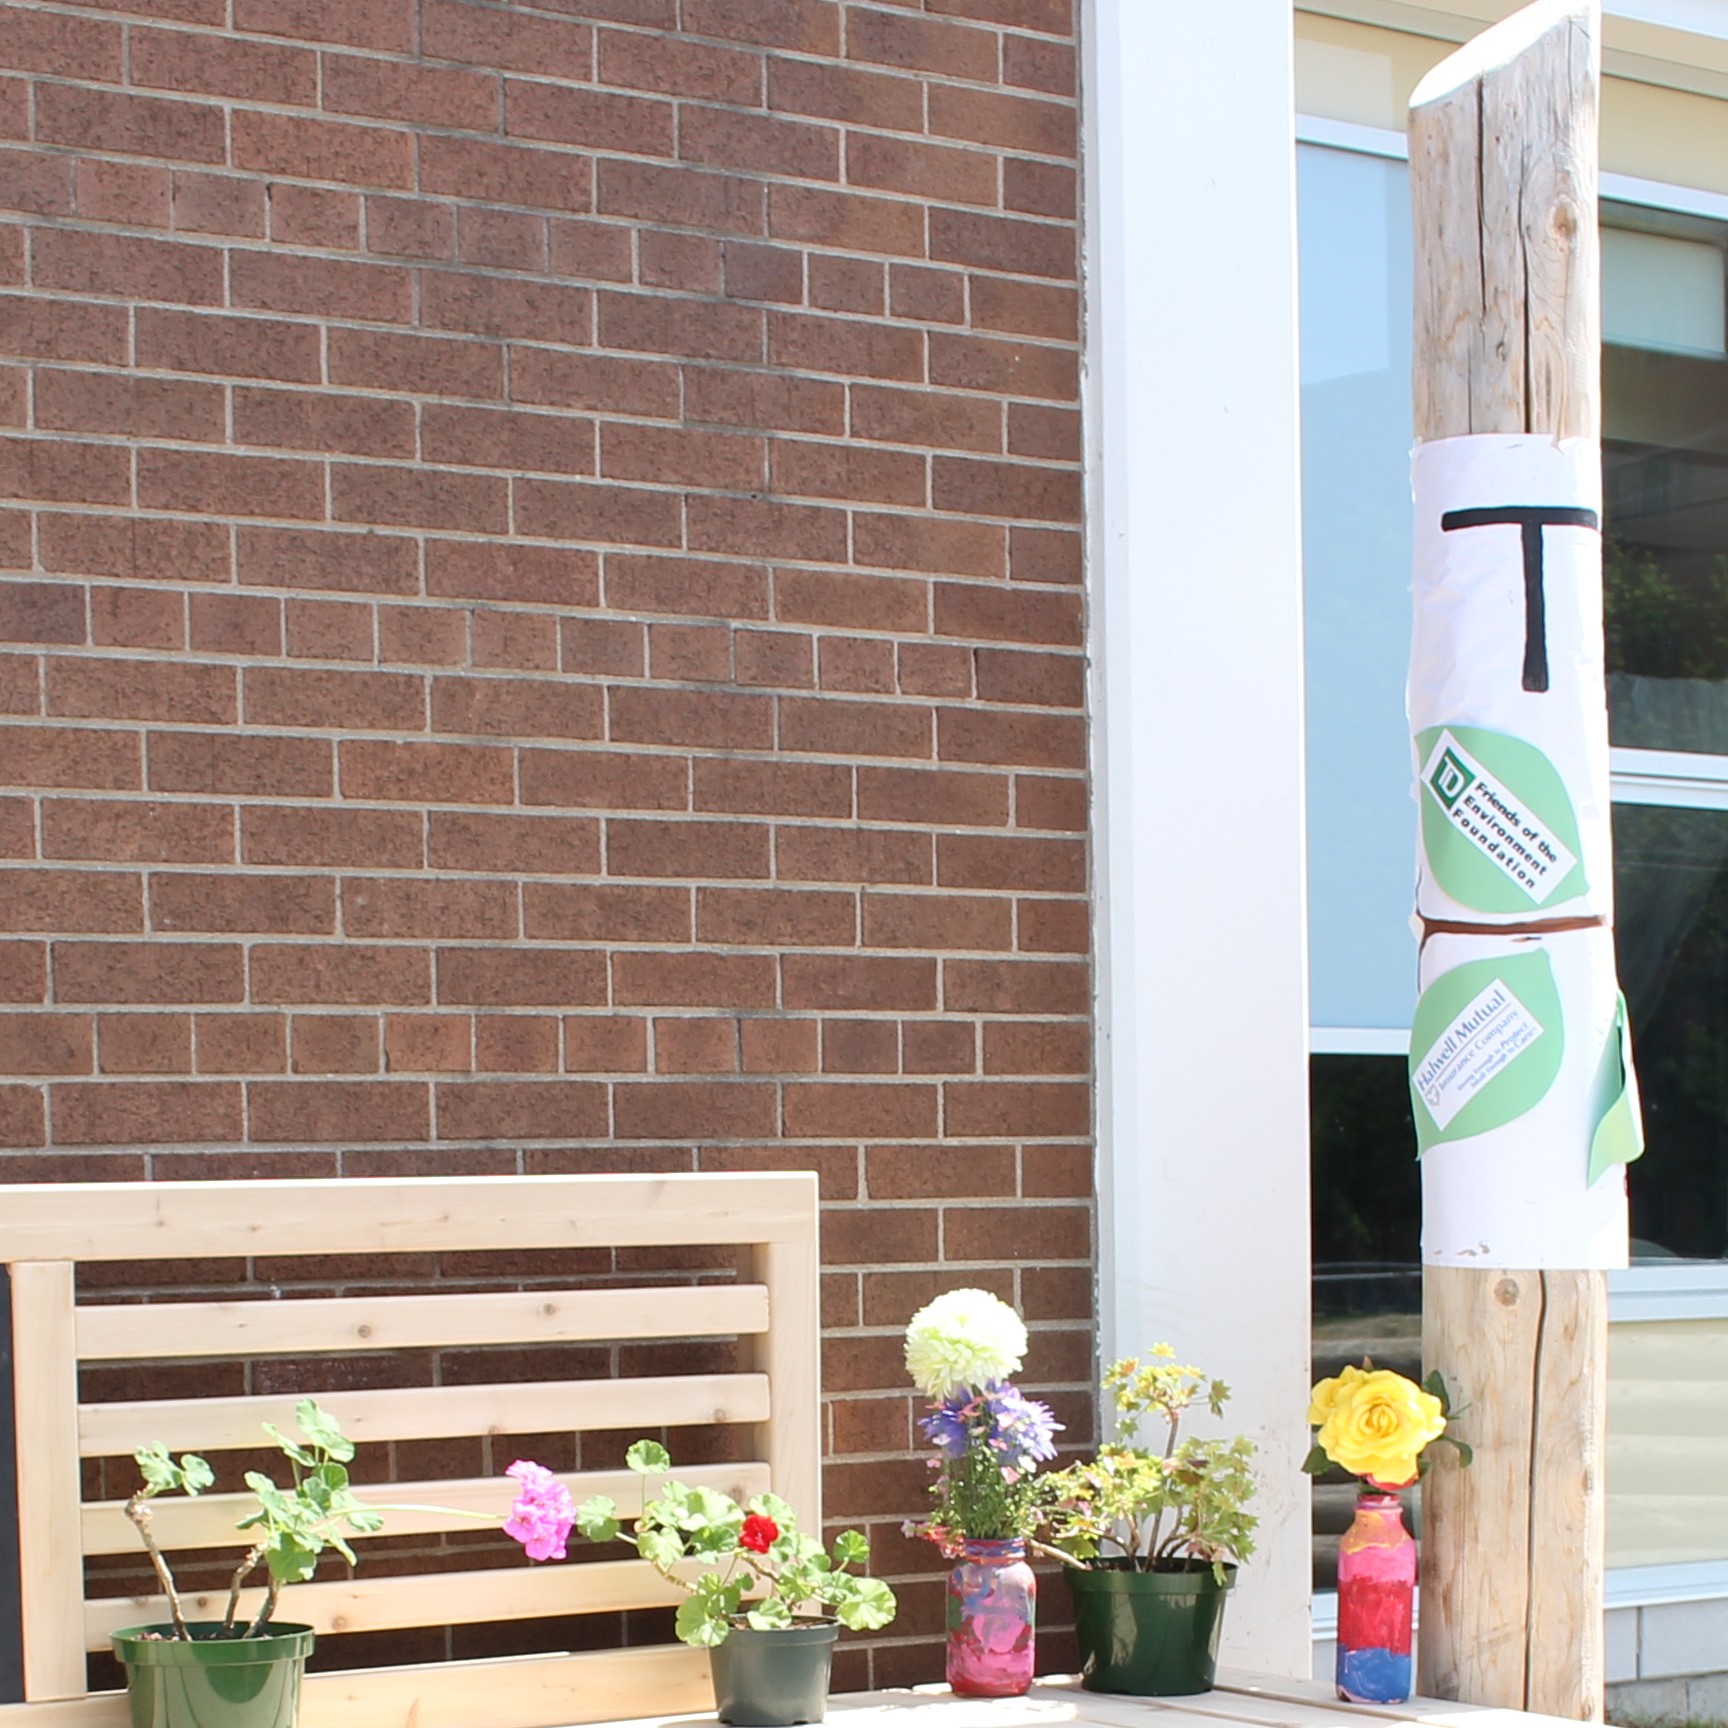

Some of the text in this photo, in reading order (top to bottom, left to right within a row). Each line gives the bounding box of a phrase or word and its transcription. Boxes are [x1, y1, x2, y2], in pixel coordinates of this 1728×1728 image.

[1441, 506, 1599, 692] T
[1452, 808, 1536, 889] Foundation
[1463, 795, 1548, 876] Environment
[1474, 781, 1558, 863] Friends of the
[1417, 988, 1507, 1092] Halwell Mutual
[1438, 1010, 1520, 1092] Insurance Company
